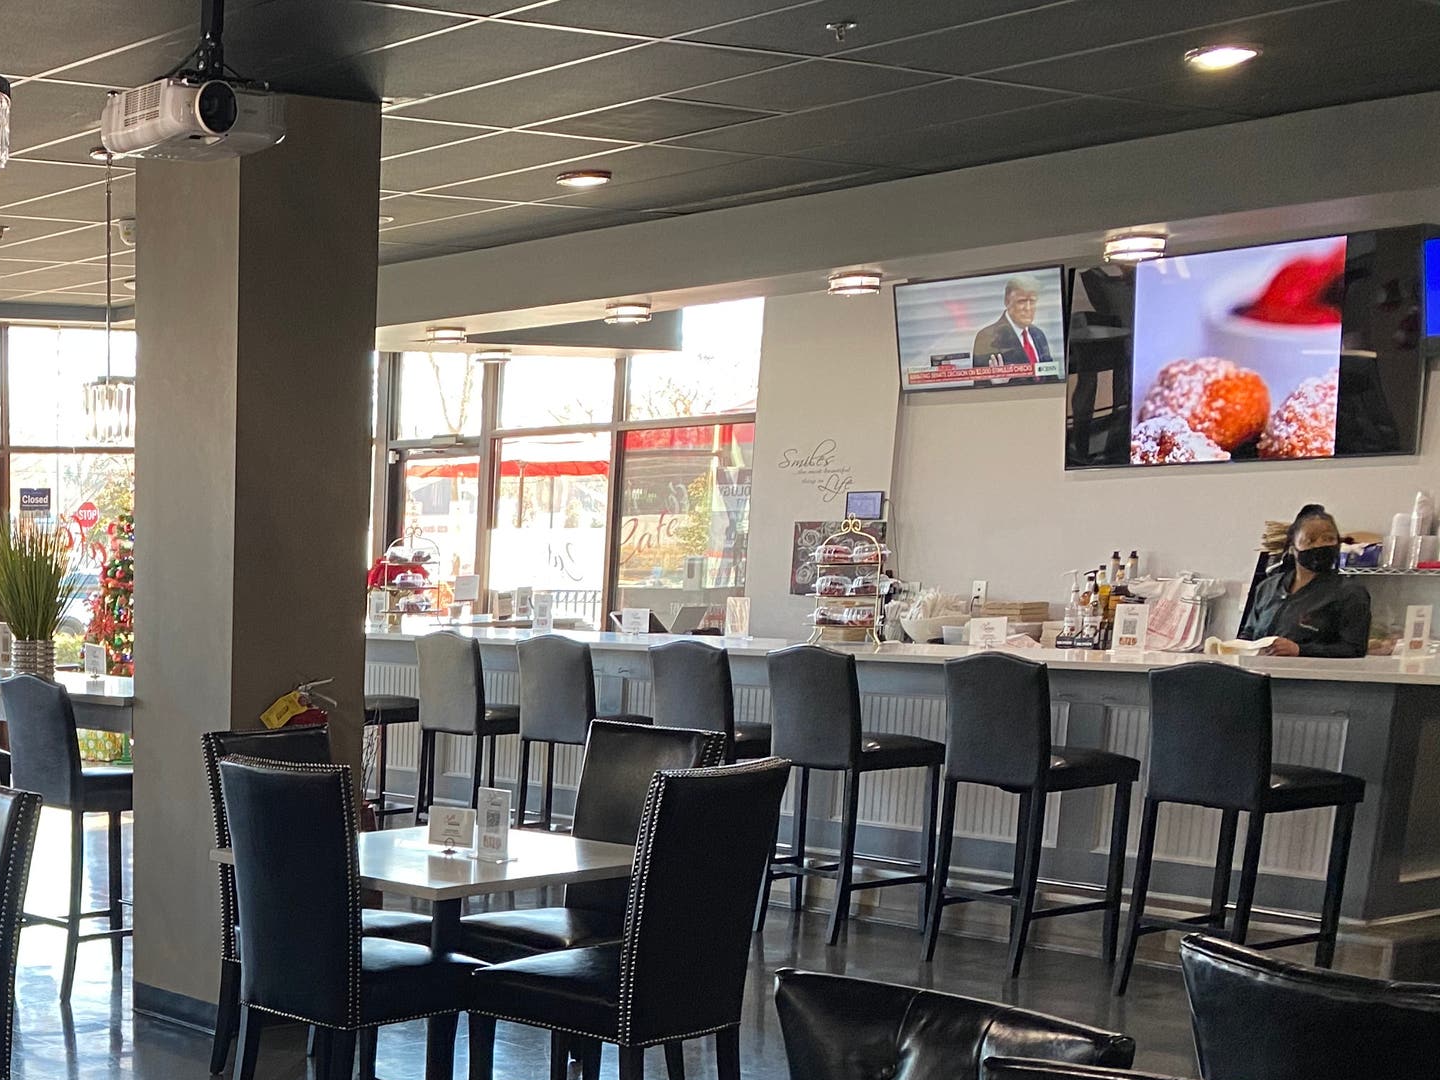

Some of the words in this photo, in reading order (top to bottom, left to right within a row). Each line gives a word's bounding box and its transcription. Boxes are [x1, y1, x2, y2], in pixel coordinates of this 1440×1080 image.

[778, 439, 836, 468] Smiles
[22, 494, 48, 504] Closed
[78, 509, 97, 520] STOP
